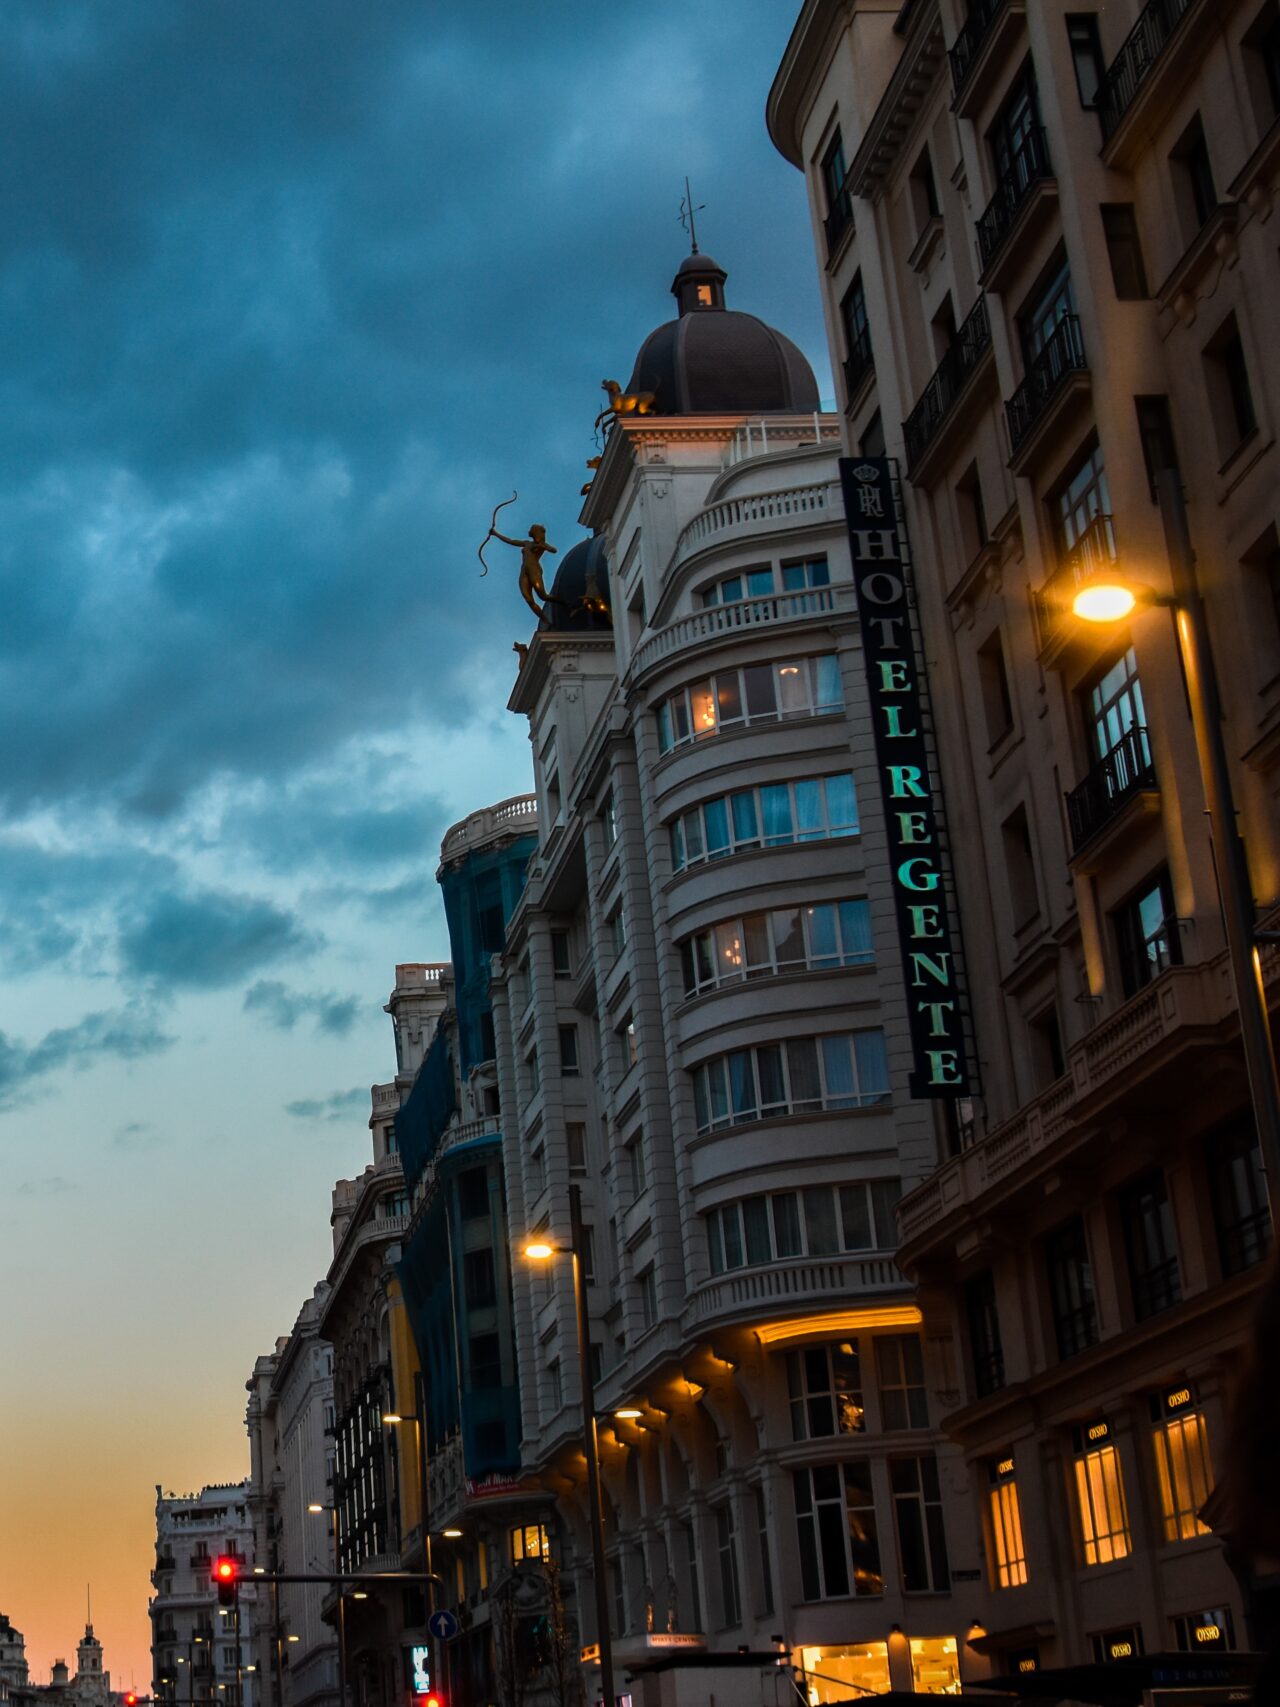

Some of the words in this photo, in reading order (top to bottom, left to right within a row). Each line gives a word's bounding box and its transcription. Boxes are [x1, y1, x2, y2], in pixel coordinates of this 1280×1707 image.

[852, 529, 917, 738] HOTEL
[885, 765, 962, 1085] REGENTE
[1167, 1389, 1191, 1408] OYSHO
[1088, 1422, 1108, 1441] OYSHO
[1195, 1625, 1220, 1642] OYSHO
[1111, 1642, 1132, 1658] OYSHO
[1019, 1659, 1035, 1672] OYSHO
